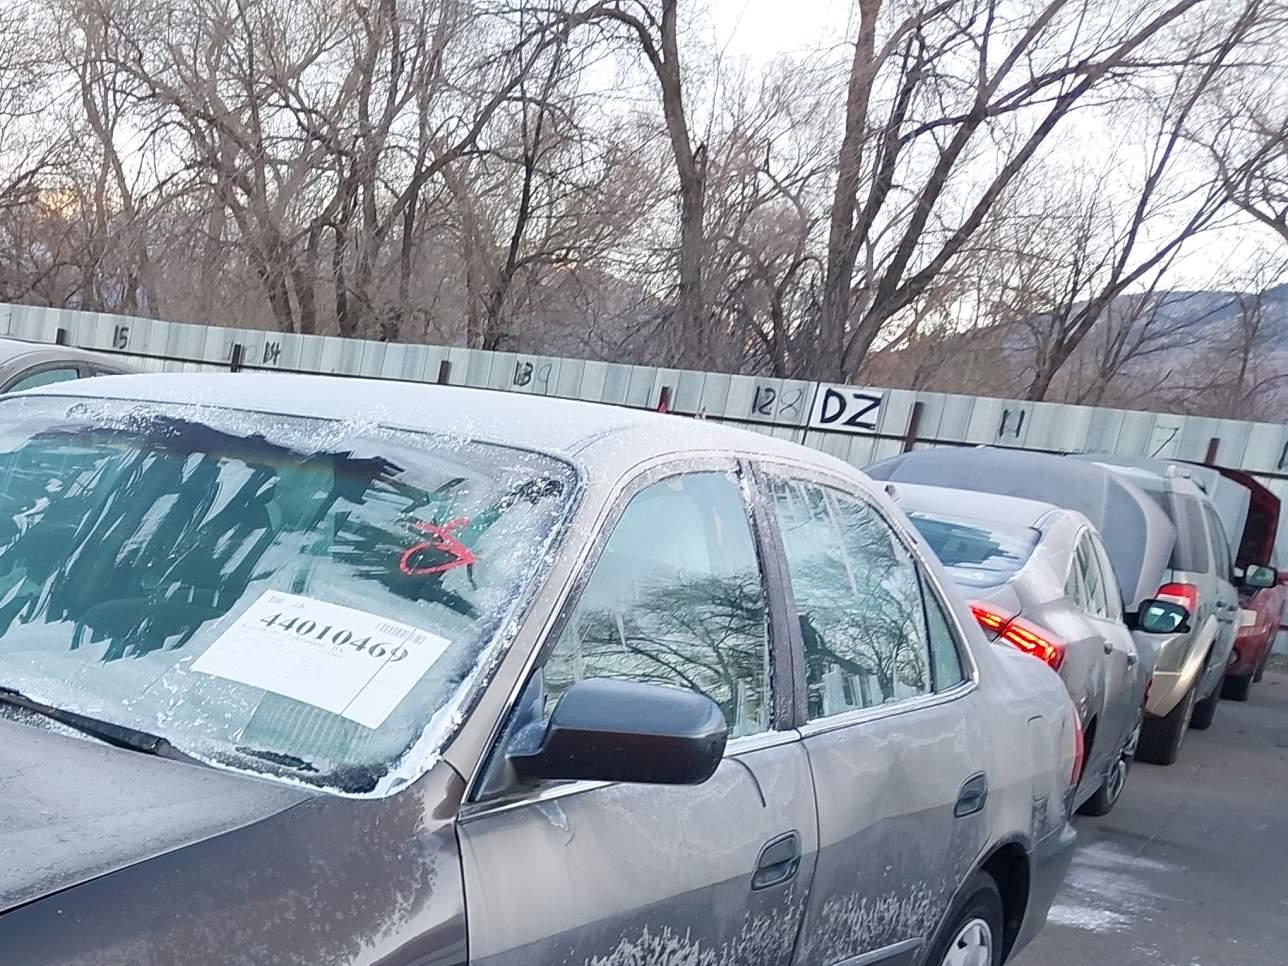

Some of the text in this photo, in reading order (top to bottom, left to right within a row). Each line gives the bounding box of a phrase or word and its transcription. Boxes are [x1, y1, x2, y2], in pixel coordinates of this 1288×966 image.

[112, 324, 130, 350] 15
[263, 340, 281, 366] 14
[512, 359, 534, 387] 13
[751, 385, 777, 416] 12
[819, 387, 883, 430] DZ
[998, 408, 1026, 438] 11
[260, 611, 410, 664] 44010469
